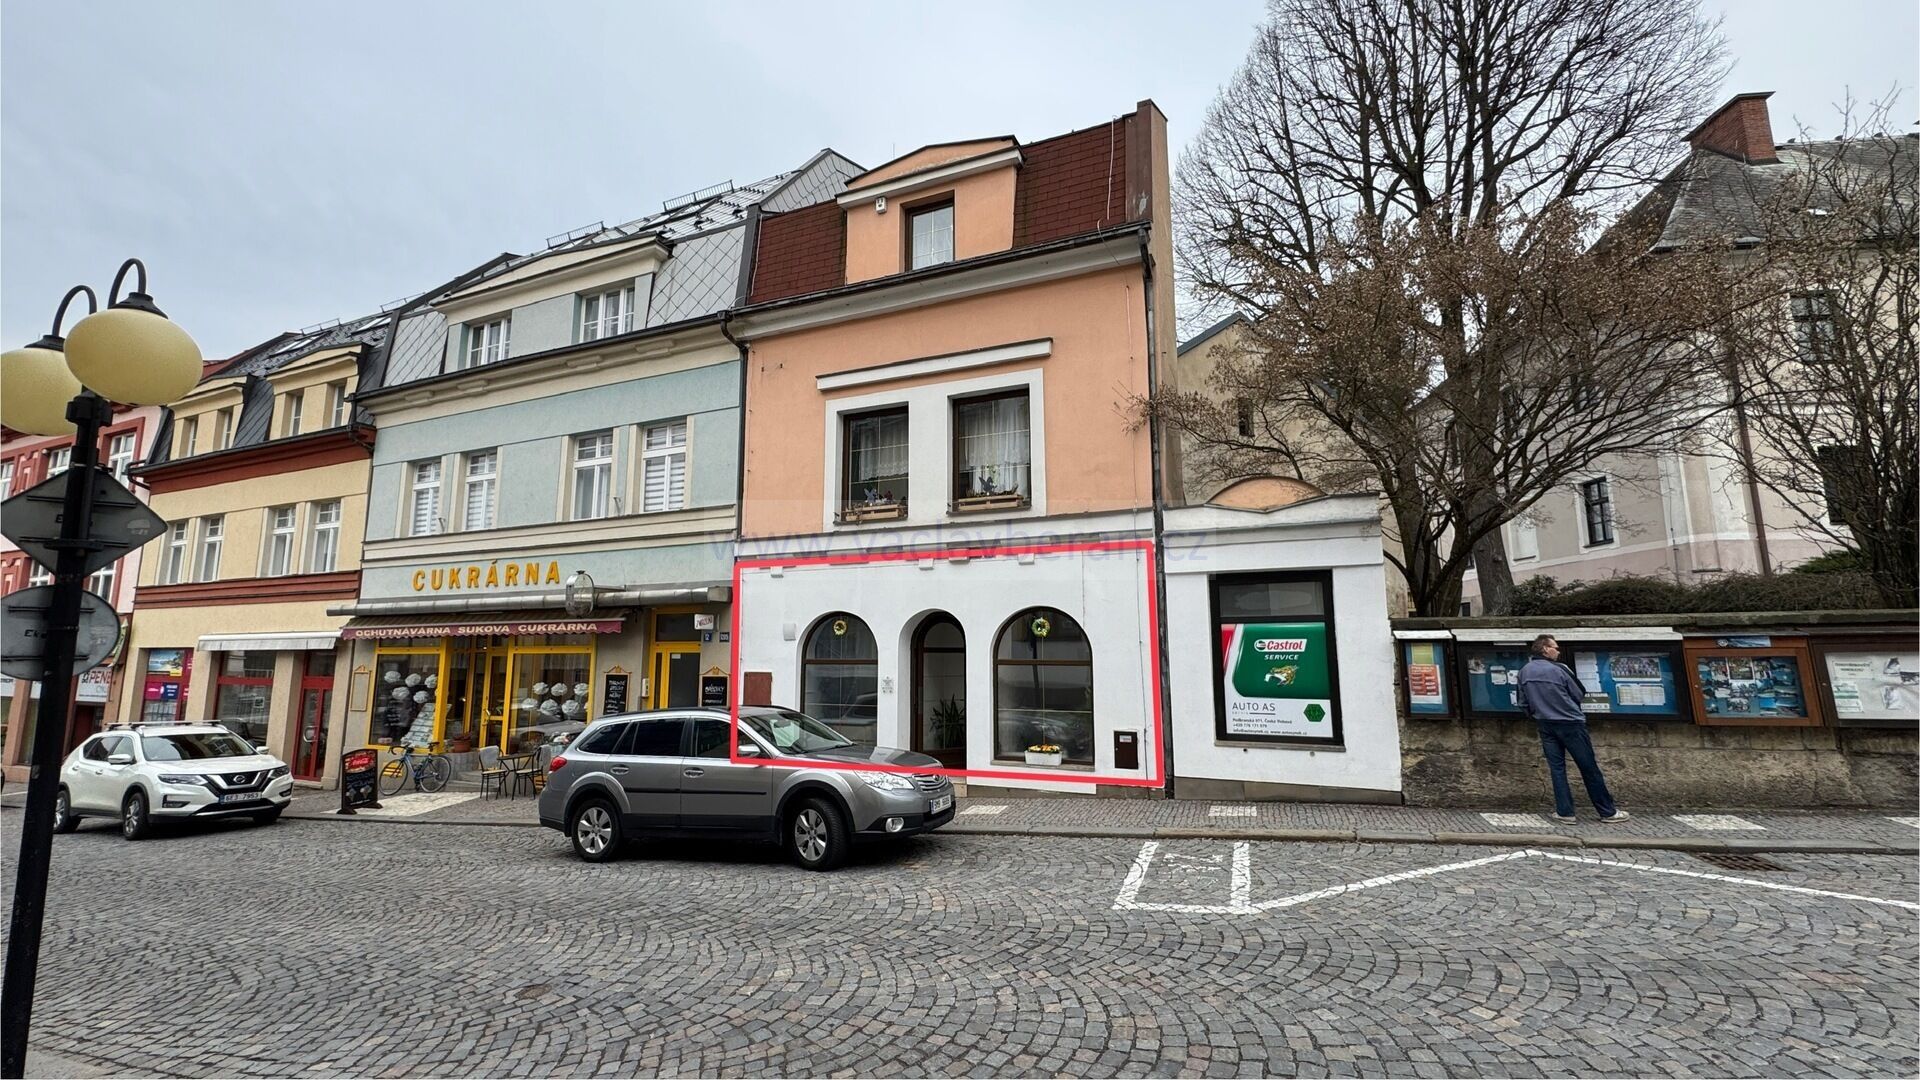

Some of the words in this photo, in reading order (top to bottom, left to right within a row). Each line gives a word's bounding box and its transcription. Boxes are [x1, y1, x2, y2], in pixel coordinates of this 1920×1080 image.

[413, 559, 560, 591] CUKRÁRNA
[457, 625, 510, 634] SUKOVA
[1266, 640, 1303, 651] Castrol
[1232, 702, 1259, 711] AUTO
[1262, 703, 1276, 712] AS
